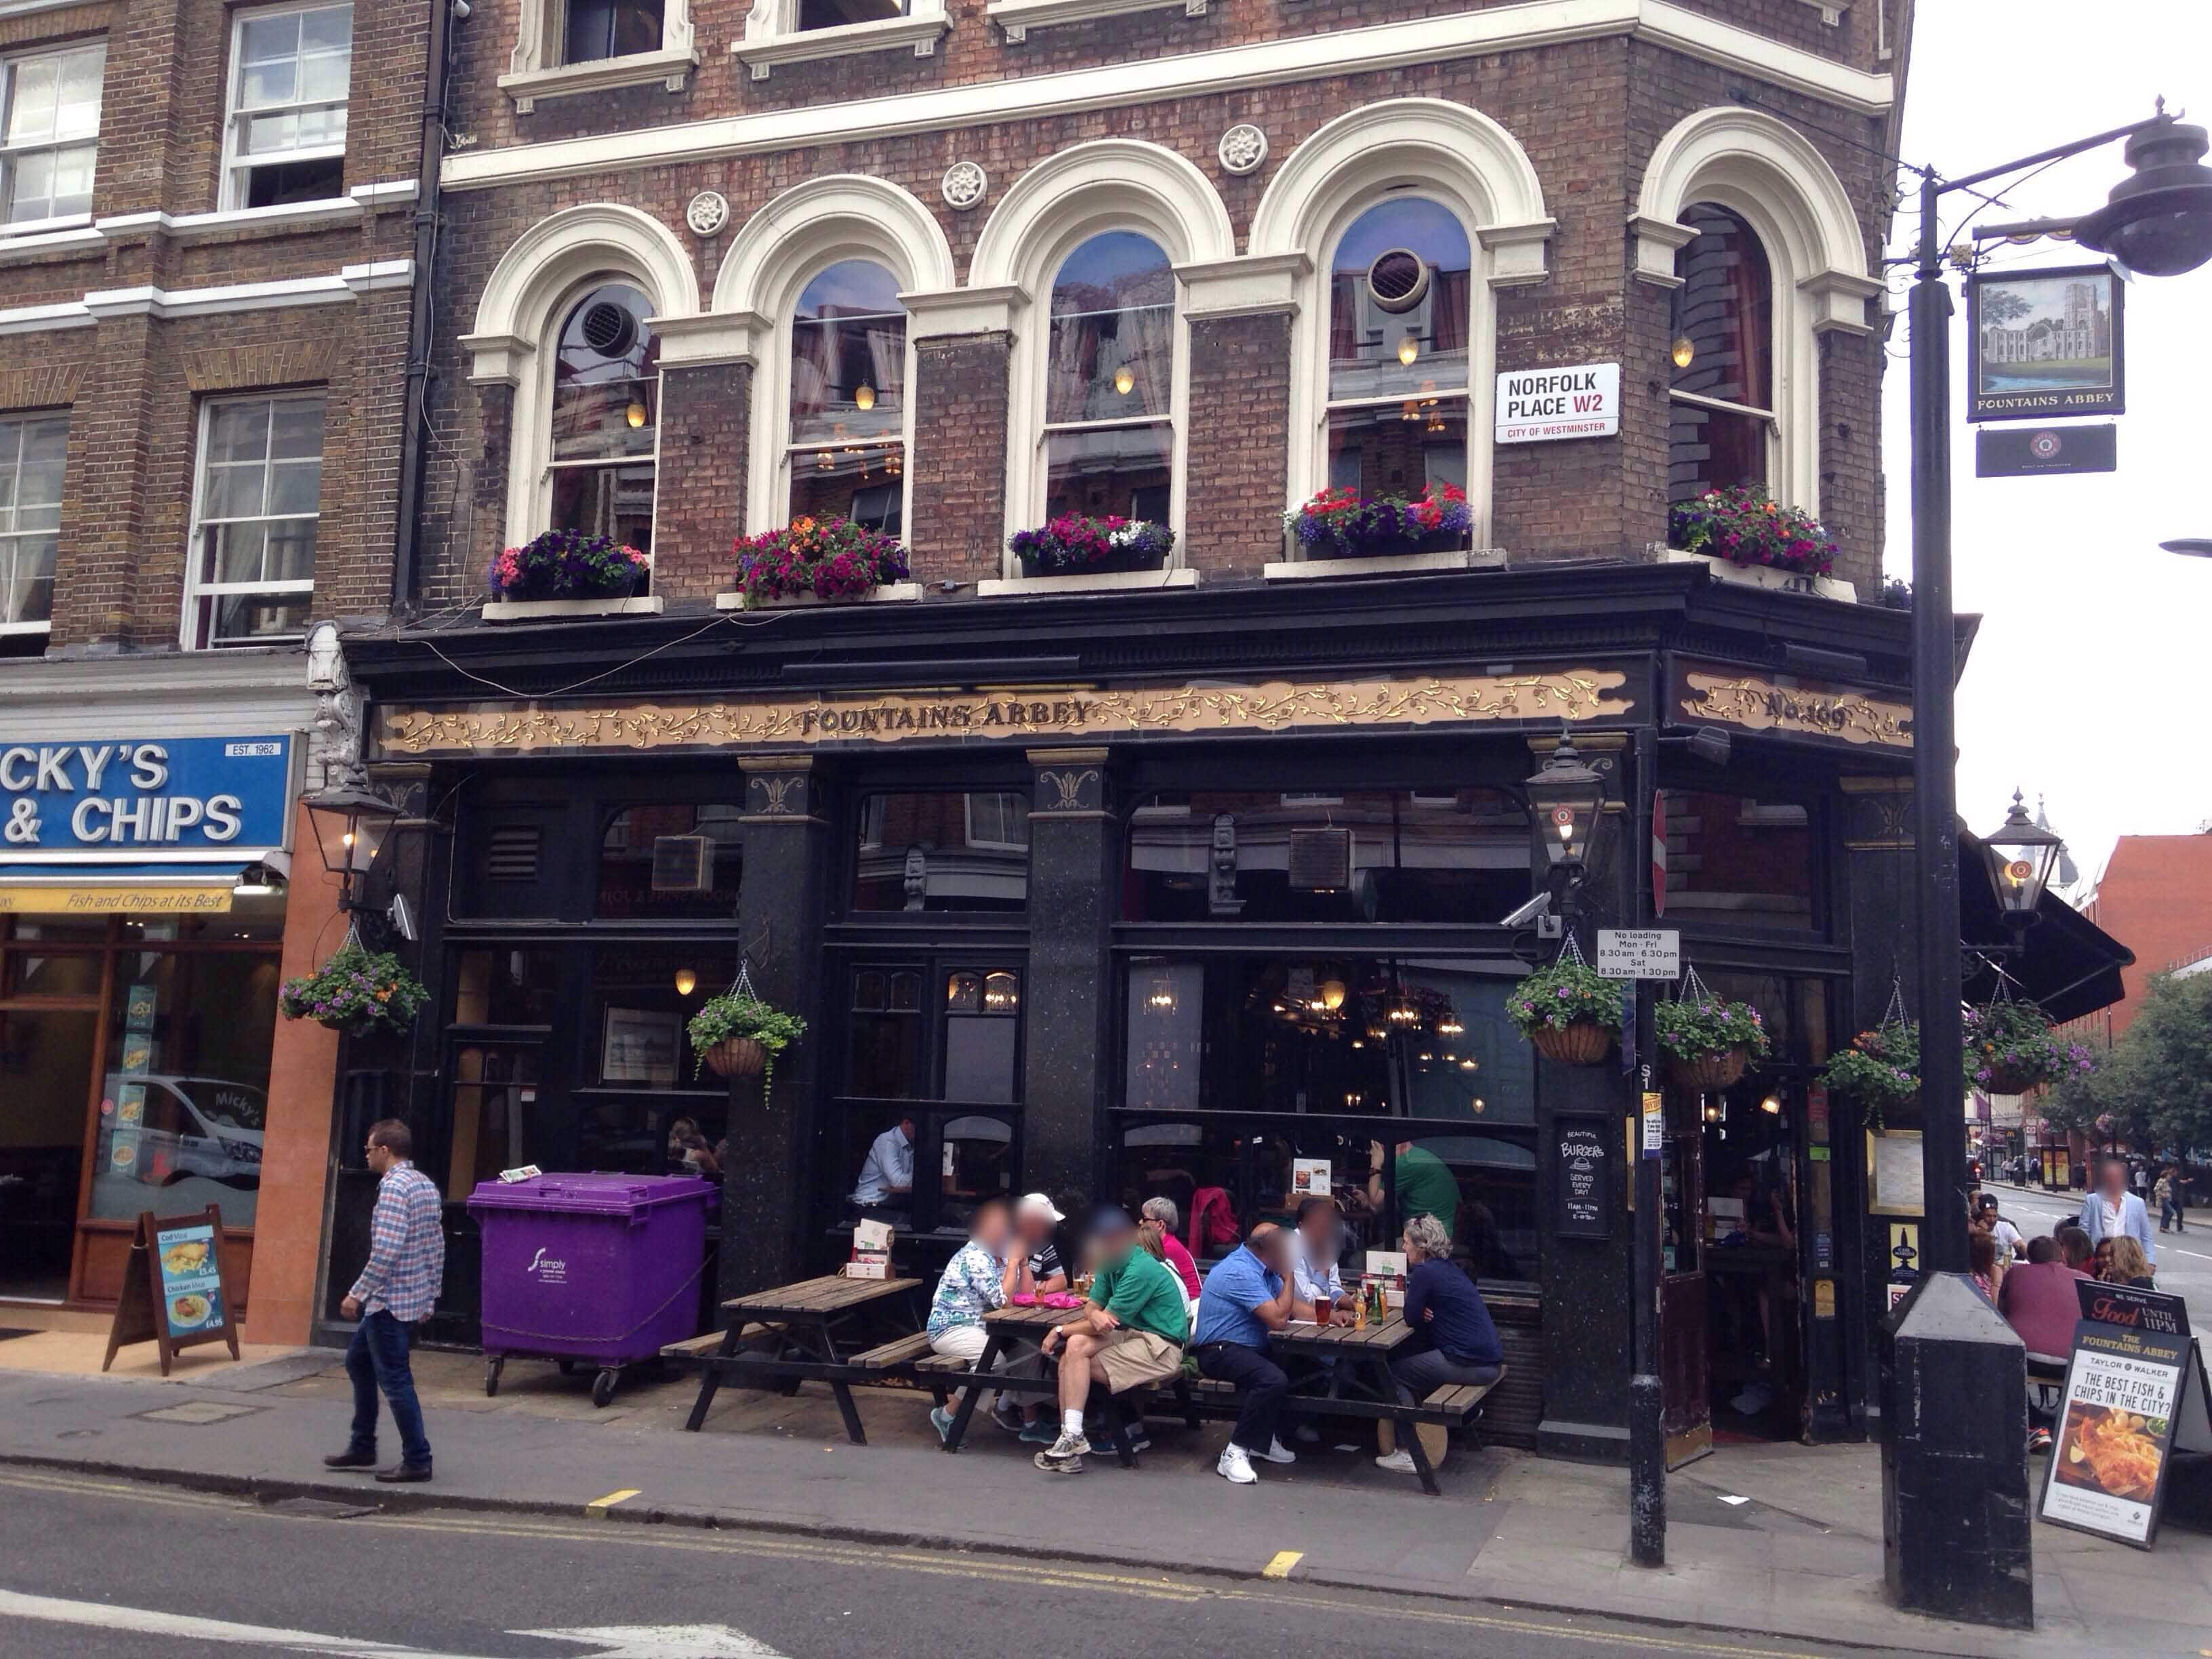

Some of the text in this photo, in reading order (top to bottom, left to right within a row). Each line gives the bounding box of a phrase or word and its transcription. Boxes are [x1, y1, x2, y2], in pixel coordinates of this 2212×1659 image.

[1509, 373, 1597, 396] NORFOLK
[1508, 394, 1602, 417] PLACE W2
[1978, 393, 2114, 410] FOUNTAINS ABBEY
[1508, 423, 1605, 438] CITY OF WESTMINSTER
[801, 701, 1091, 737] FOUNTAINS ABBEY
[233, 743, 274, 755] EST. 1962
[5, 794, 242, 842] & CHIPS
[67, 894, 94, 907] Fish
[95, 895, 121, 907] and
[122, 895, 157, 910] Chips
[159, 895, 171, 907] at
[176, 895, 191, 907] its
[193, 894, 224, 907] Best
[1630, 932, 1662, 940] loading
[216, 1092, 260, 1126] Micky's
[1561, 1142, 1604, 1158] BURGERS
[1570, 1173, 1593, 1182] SERVED
[540, 1259, 565, 1270] simply
[167, 1284, 191, 1293] Chicken
[2126, 1296, 2148, 1304] SERVE
[2092, 1297, 2175, 1326] Food UNTIL
[2145, 1317, 2177, 1334] 11PM
[2122, 1334, 2141, 1343] THE
[2082, 1336, 2177, 1359] FOUNTAINS ABBEY
[2091, 1357, 2168, 1377] TAYLOR WALKER
[2086, 1372, 2165, 1399] THE BEST FISH &
[2074, 1385, 2171, 1415] CHIPS IN THE CITY?
